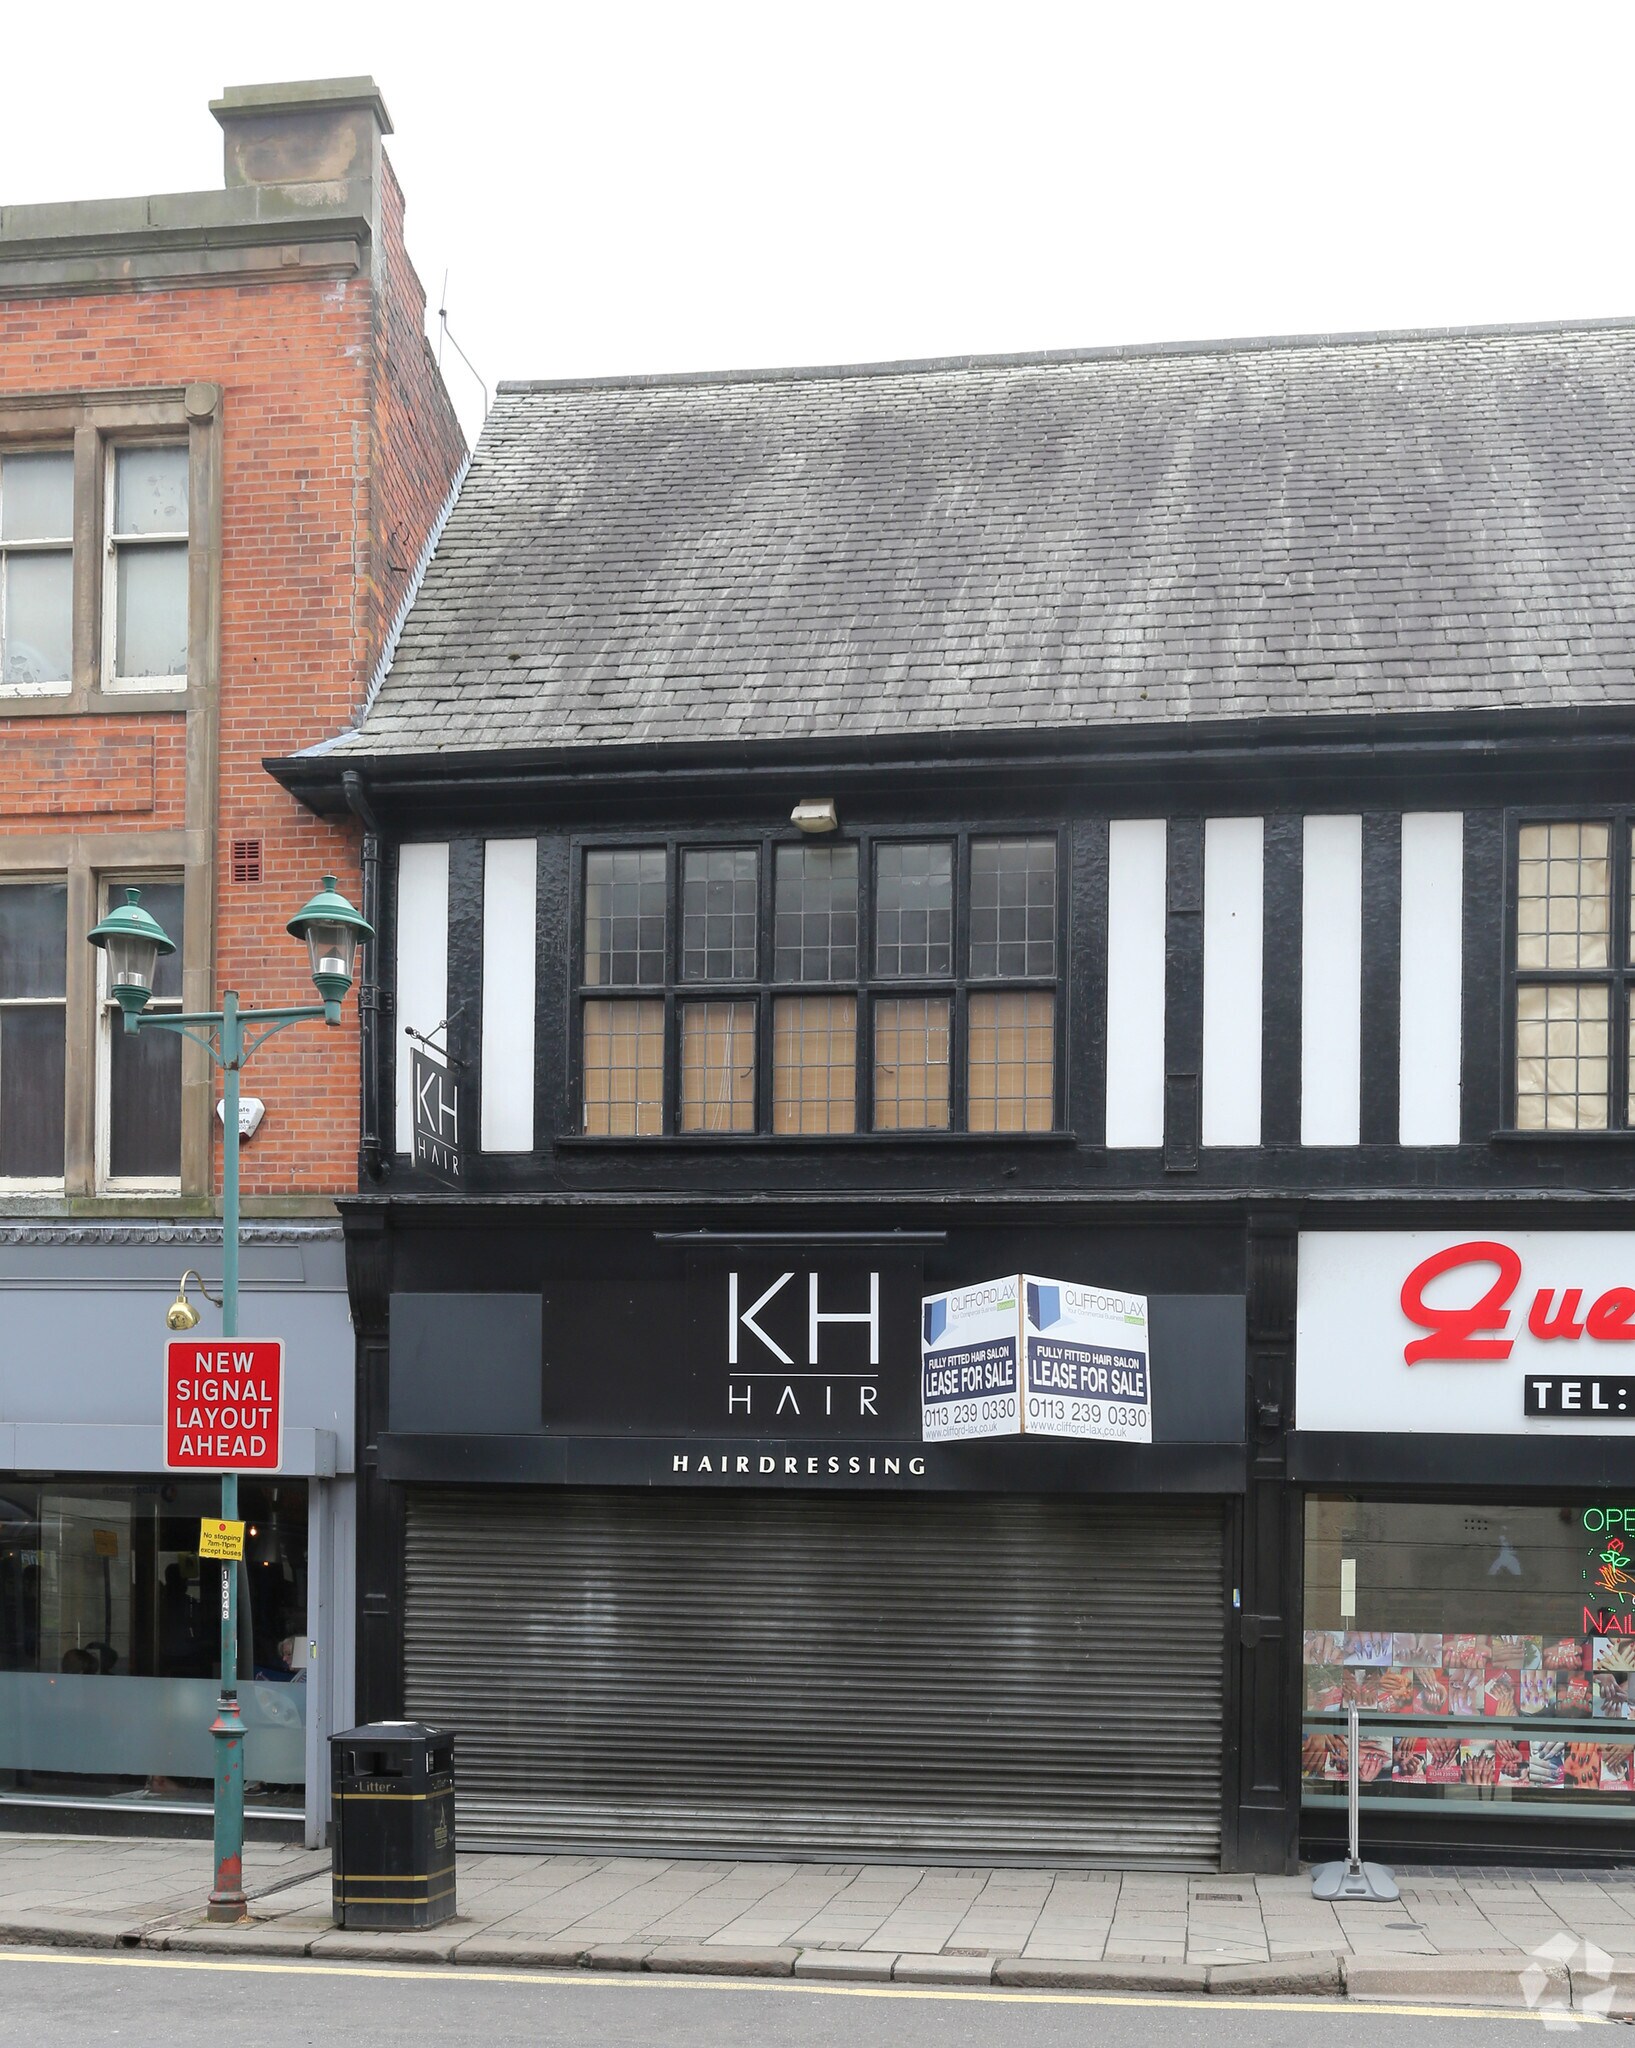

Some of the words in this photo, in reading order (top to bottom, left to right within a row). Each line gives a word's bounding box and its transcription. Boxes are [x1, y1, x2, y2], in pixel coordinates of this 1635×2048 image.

[417, 1063, 458, 1144] KH
[418, 1137, 459, 1176] HAIR
[1400, 1240, 1635, 1367] Que
[729, 1272, 879, 1364] KH
[196, 1352, 254, 1373] NEW
[929, 1357, 947, 1369] FULLY
[948, 1353, 970, 1367] FITTED
[971, 1350, 986, 1363] HAIR
[987, 1346, 1009, 1360] SALON
[1037, 1346, 1063, 1359] FULLY
[1064, 1349, 1090, 1363] FITTED
[1092, 1353, 1112, 1366] HAIR
[1113, 1356, 1140, 1369] SALON
[926, 1369, 959, 1397] LEASE
[961, 1365, 983, 1392] FOR
[985, 1360, 1013, 1389] SALE
[1033, 1360, 1078, 1389] LEASE
[1081, 1366, 1108, 1393] FOR
[1111, 1370, 1144, 1397] SALE
[176, 1380, 272, 1401] SIGNAL
[728, 1385, 879, 1415] HAIR
[1532, 1382, 1627, 1410] TEL:
[176, 1407, 272, 1429] LAYOUT
[925, 1407, 948, 1427] 0113
[954, 1403, 977, 1423] 239
[982, 1398, 1015, 1420] 0330
[1029, 1398, 1065, 1420] 0113
[1071, 1402, 1101, 1423] 239
[1108, 1406, 1147, 1427] 0330
[926, 1422, 997, 1439] www.clifford-lax.co.uk
[1030, 1421, 1127, 1437] www.clifford-lax.co.uk
[179, 1435, 266, 1456] AHEAD
[672, 1455, 925, 1475] HAIRDRESSING
[1584, 1508, 1635, 1531] OPE
[214, 1533, 240, 1542] stopping
[359, 1781, 391, 1793] Litter
